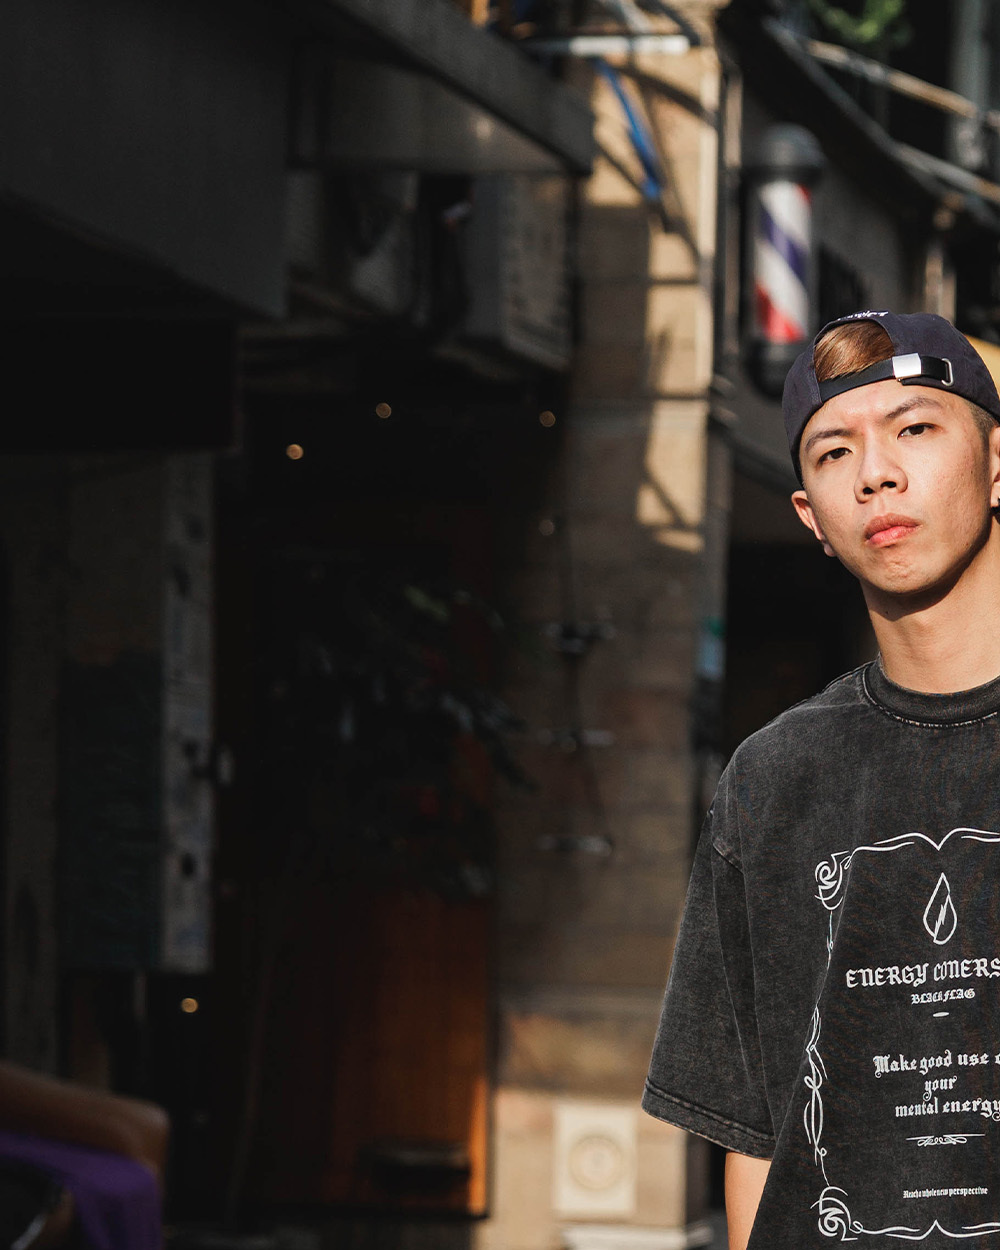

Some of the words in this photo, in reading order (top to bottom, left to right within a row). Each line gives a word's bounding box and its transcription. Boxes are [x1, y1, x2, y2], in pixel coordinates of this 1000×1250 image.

[846, 963, 929, 988] ENERGY
[873, 1054, 917, 1078] Make
[919, 1049, 952, 1075] good
[958, 1053, 989, 1066] use
[923, 1074, 958, 1102] your
[895, 1096, 938, 1117] mental
